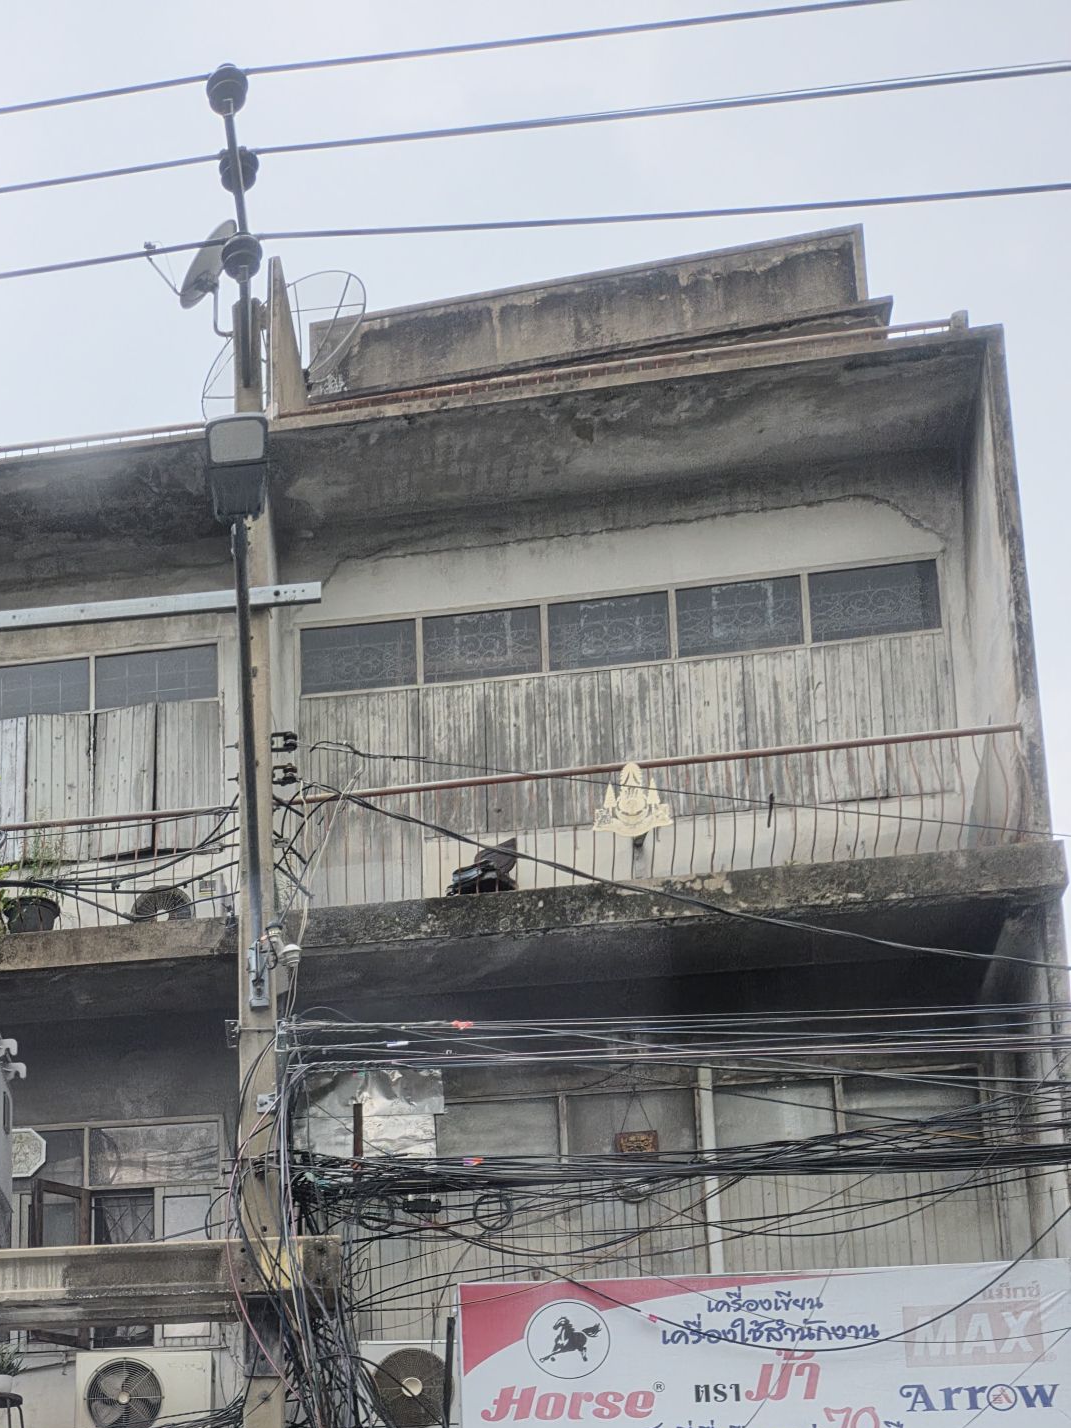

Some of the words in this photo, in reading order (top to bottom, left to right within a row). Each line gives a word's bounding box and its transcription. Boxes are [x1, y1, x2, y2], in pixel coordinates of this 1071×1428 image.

[707, 1286, 824, 1313] เครื่องเขียน
[661, 1314, 880, 1345] เครื่องใช้สำนักงาน
[913, 1310, 1035, 1356] MAX
[695, 1382, 740, 1403] ตรา
[744, 1350, 821, 1402] ม้า
[480, 1385, 656, 1422] Horse
